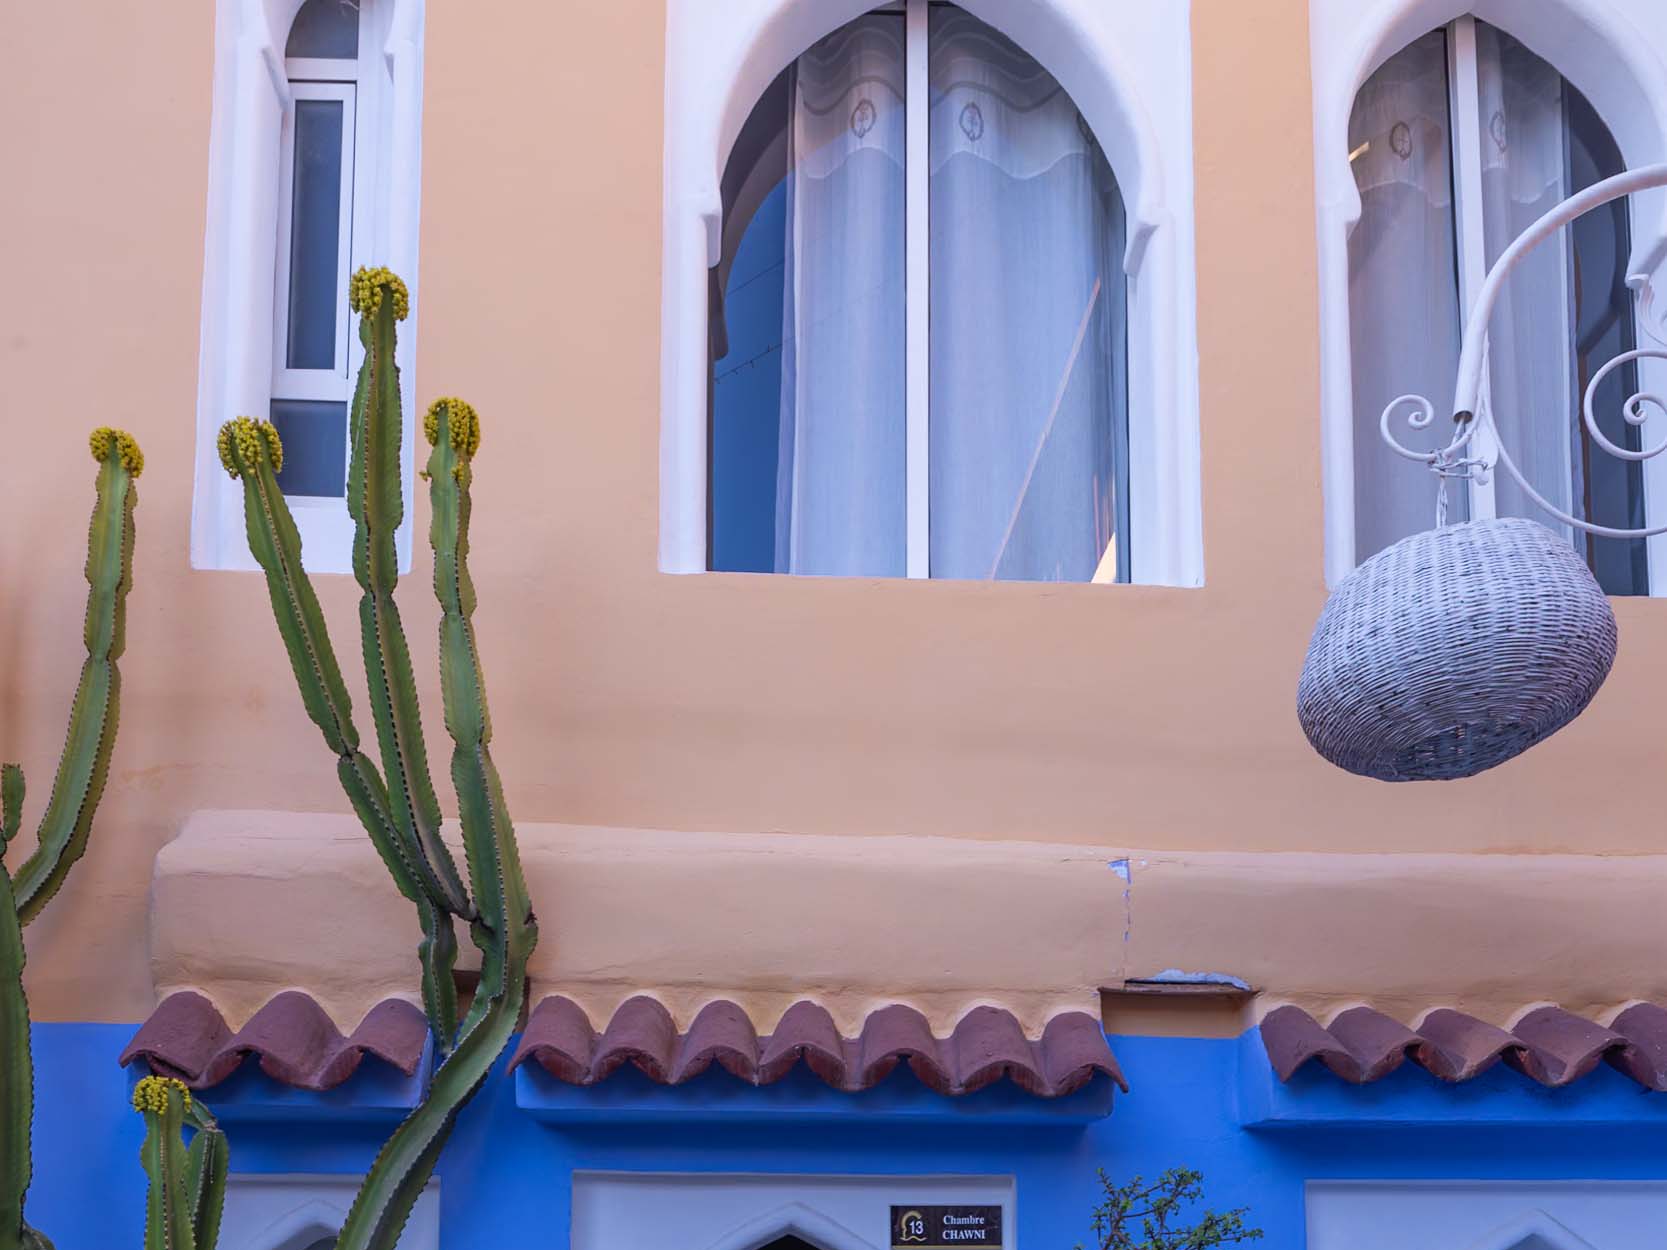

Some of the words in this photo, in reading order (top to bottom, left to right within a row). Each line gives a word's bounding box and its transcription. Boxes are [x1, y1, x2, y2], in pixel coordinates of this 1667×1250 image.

[943, 1215, 985, 1225] Chambre
[909, 1220, 924, 1235] 13
[942, 1229, 986, 1240] CHAWNI
